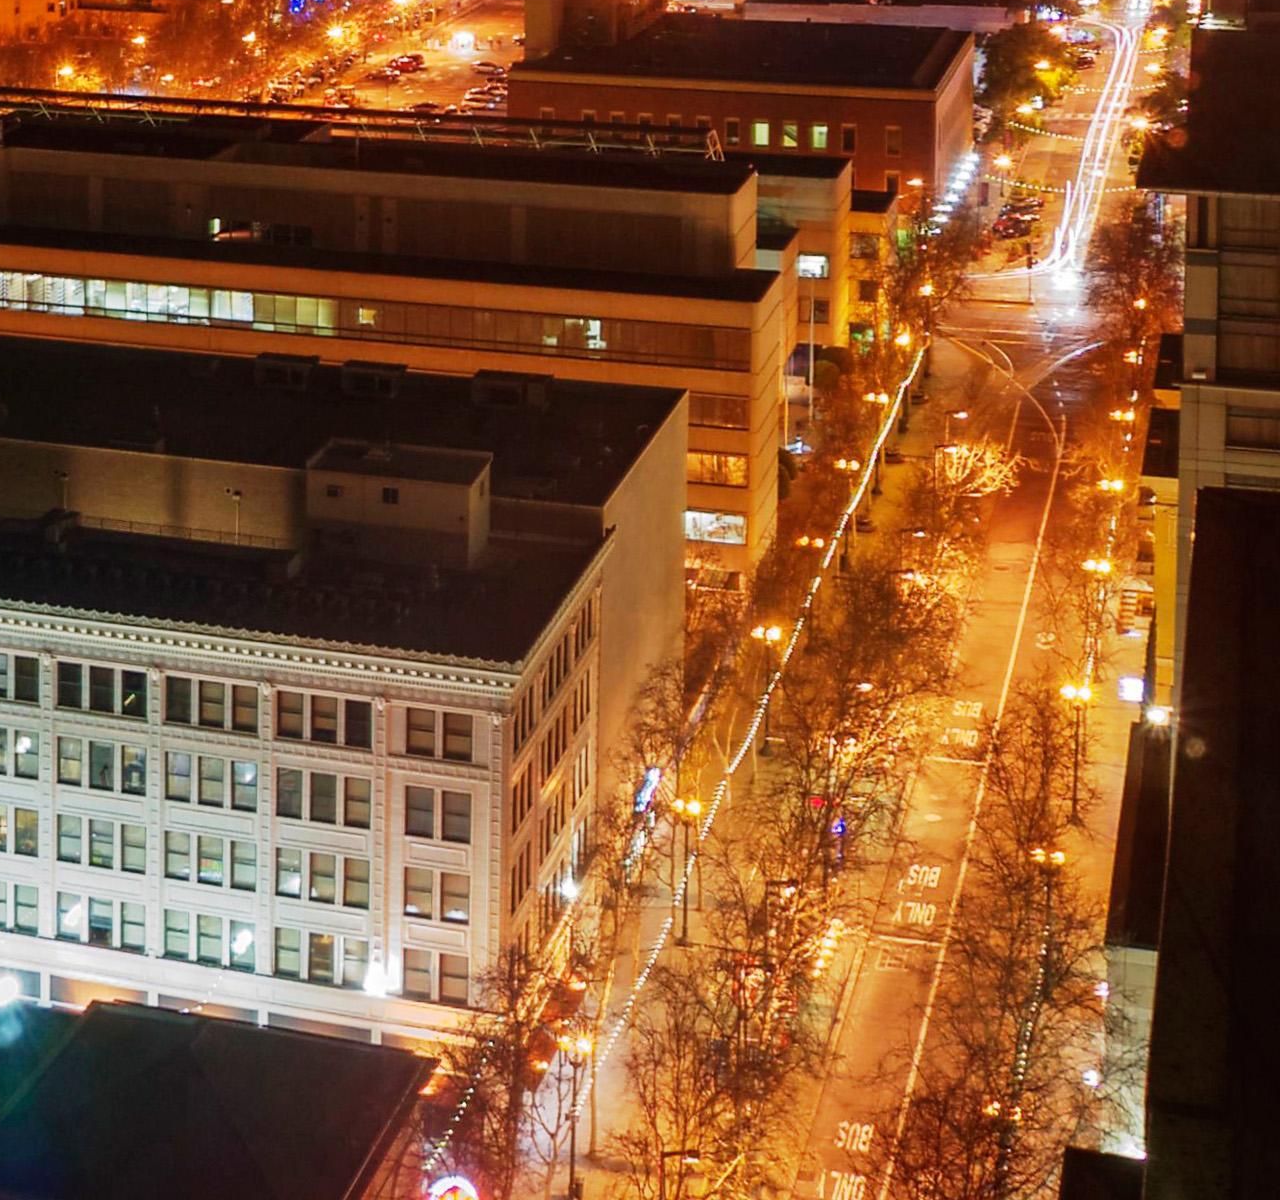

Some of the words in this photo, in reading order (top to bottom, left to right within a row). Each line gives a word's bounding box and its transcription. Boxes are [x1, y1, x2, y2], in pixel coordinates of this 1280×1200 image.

[952, 700, 983, 717] BUS
[941, 727, 979, 747] ONLY
[907, 864, 941, 888] BUS
[891, 900, 937, 926] ONLY
[833, 1120, 875, 1152] BUS
[816, 1168, 867, 1200] ONLY
